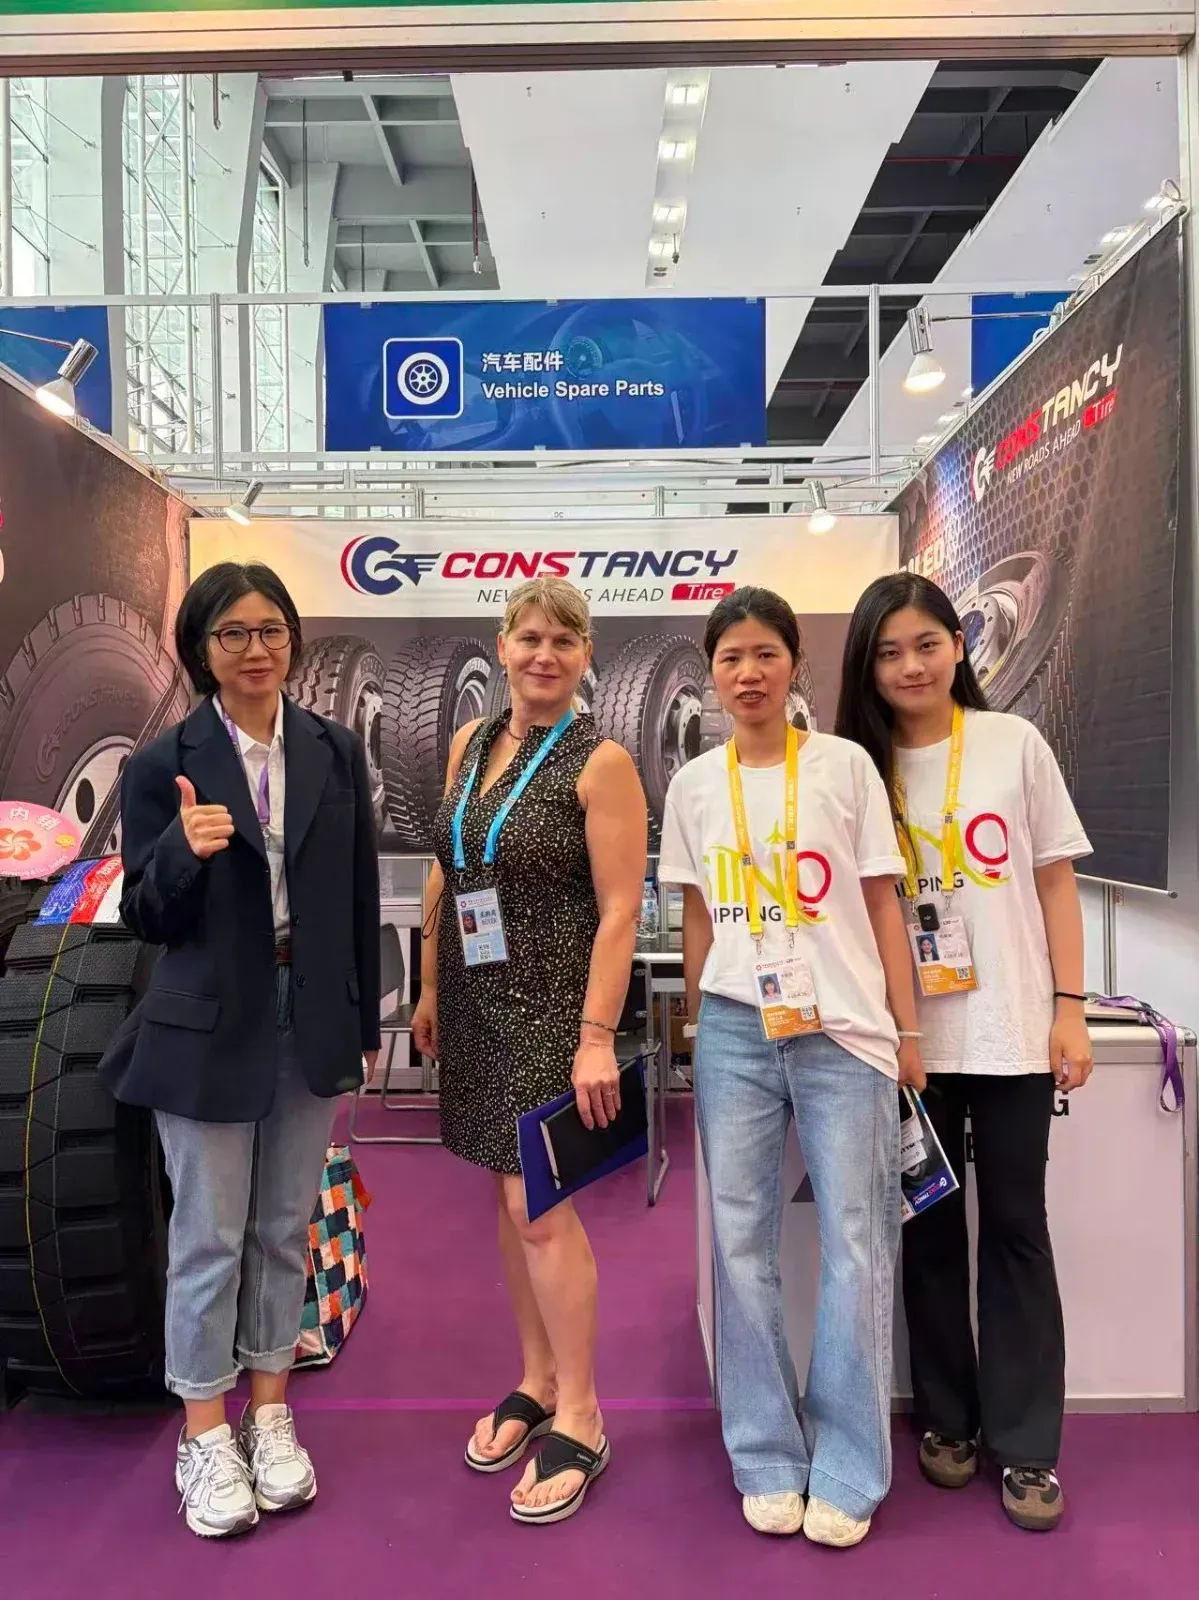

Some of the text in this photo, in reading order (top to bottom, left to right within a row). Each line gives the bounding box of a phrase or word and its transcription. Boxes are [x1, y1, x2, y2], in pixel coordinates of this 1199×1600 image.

[482, 351, 564, 372] 汽车配件
[482, 380, 664, 400] Vehicle Spare Parts
[1093, 397, 1114, 422] Tire
[1008, 420, 1081, 485] NEW ROADS AHEAD
[441, 549, 739, 580] CONSTANCY
[598, 588, 664, 602] AHEAD
[687, 584, 724, 601] Tire
